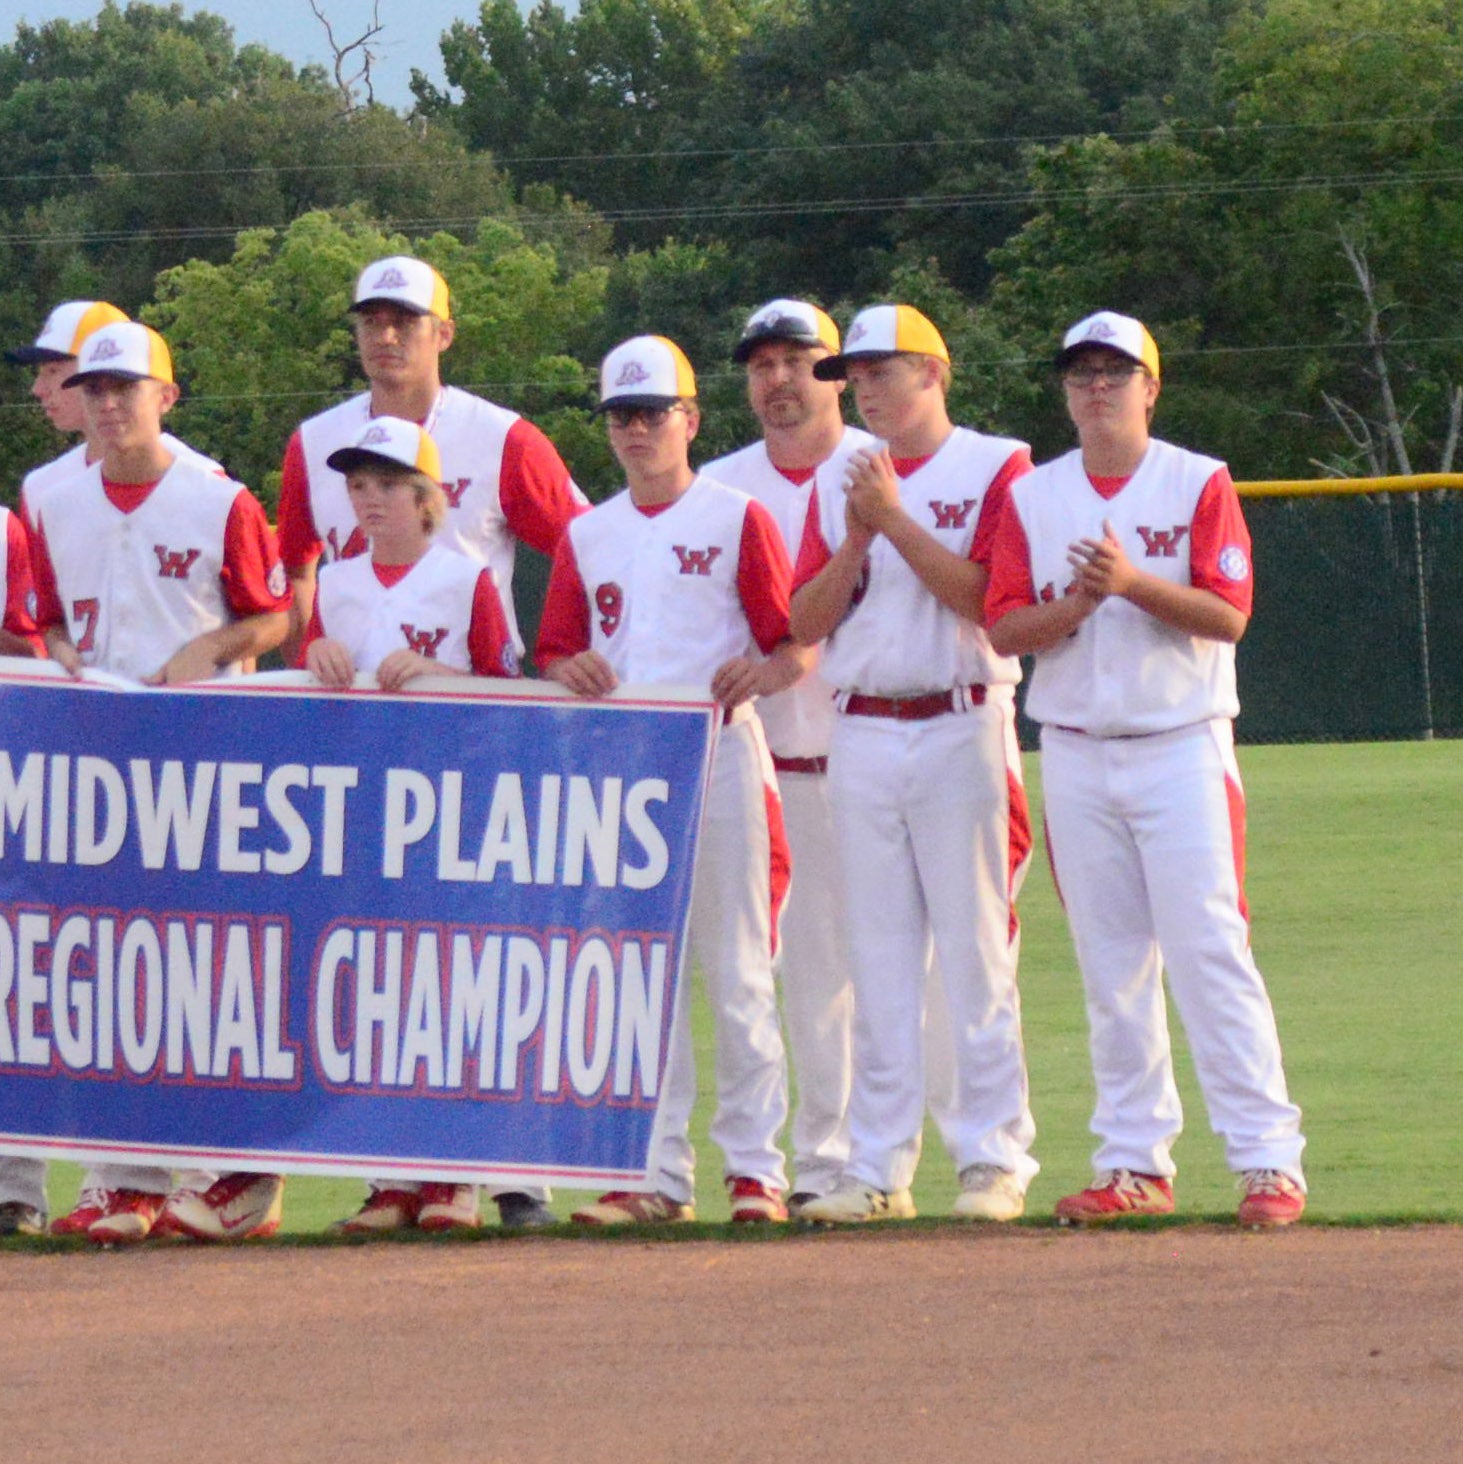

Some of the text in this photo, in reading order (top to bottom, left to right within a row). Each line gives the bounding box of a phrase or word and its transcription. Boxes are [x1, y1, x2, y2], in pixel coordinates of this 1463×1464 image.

[928, 499, 977, 529] W
[1136, 525, 1189, 557] W
[154, 544, 201, 579] W
[672, 545, 723, 576] W
[72, 597, 100, 653] 7
[594, 581, 623, 639] 9
[399, 623, 450, 657] W
[382, 767, 670, 890] PLAINS
[314, 926, 668, 1099] CHAMPION
